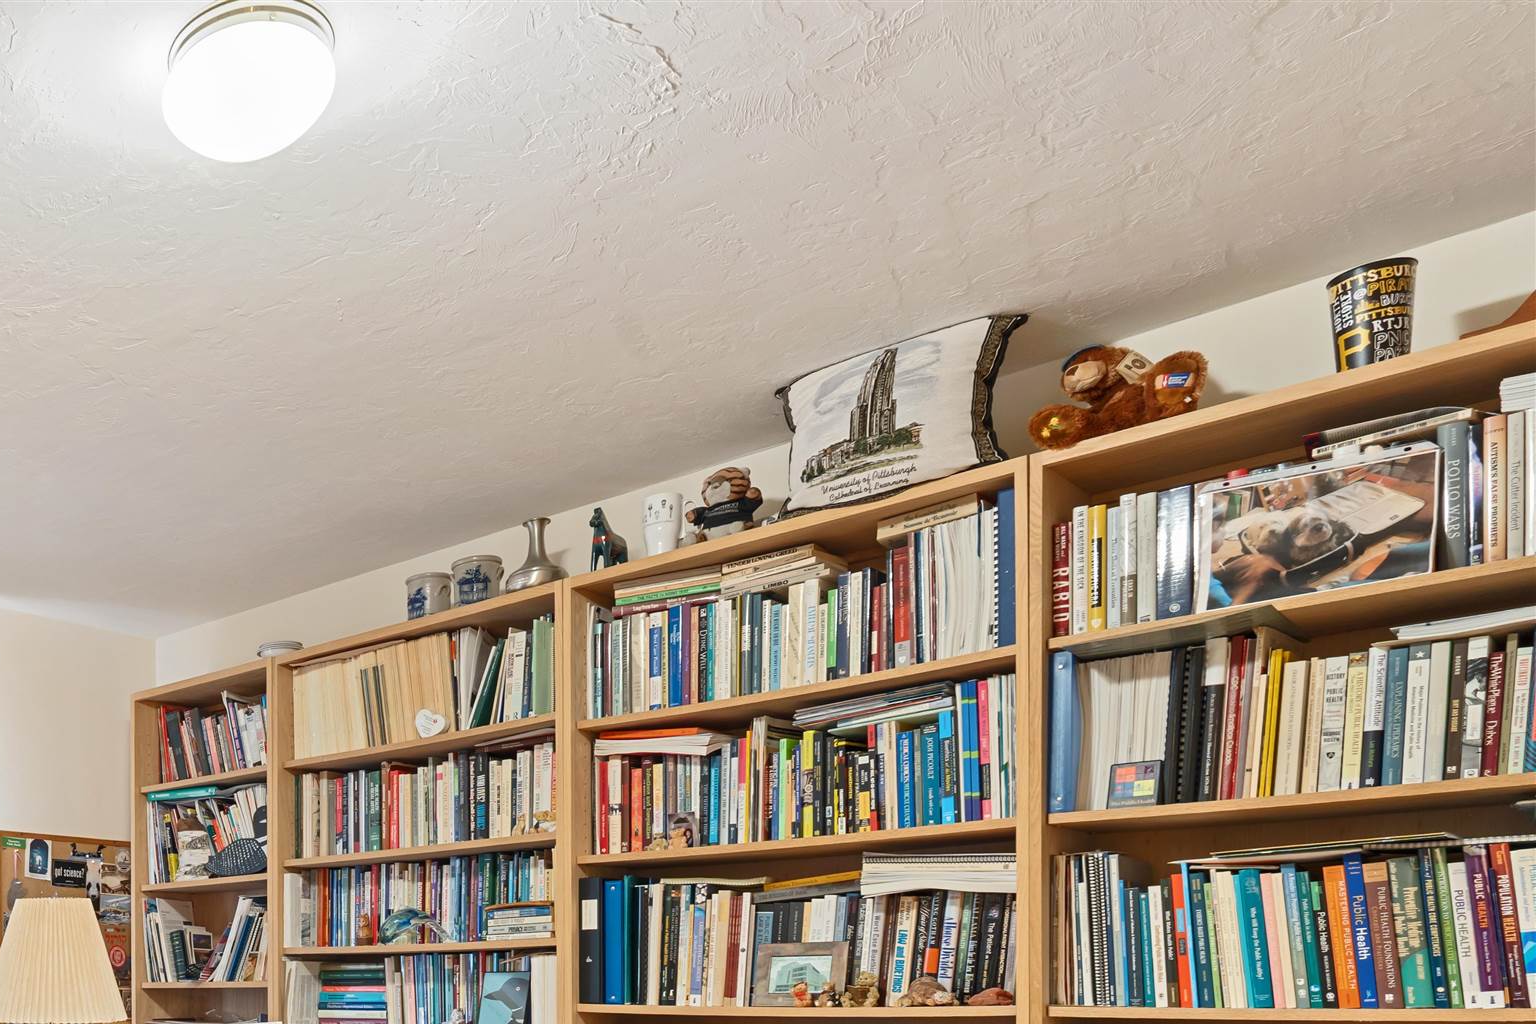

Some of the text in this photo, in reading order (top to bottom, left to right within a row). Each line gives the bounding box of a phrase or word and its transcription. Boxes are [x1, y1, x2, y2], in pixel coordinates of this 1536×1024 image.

[1447, 459, 1461, 540] POLIO WARS
[1490, 441, 1499, 548] AUTISM'S FALSE PROPHETS
[1510, 460, 1521, 532] The Cutter Incident
[726, 547, 797, 569] TENDER LOVING GREED
[762, 580, 789, 591] LIMBO
[1052, 566, 1070, 623] RABID
[699, 629, 709, 671] DYING WELL
[1373, 654, 1387, 727] The Scientific Attitude
[926, 737, 935, 780] JODI PICOULT
[1484, 720, 1498, 746] Dubos
[54, 865, 85, 879] got science?
[1352, 895, 1370, 961] Public Health
[1394, 916, 1407, 935] Public
[1402, 886, 1424, 949] Preventive Medicine
[1454, 889, 1471, 958] PUBLIC HEALTH
[1473, 873, 1489, 929] PUBLIC HEALTH
[1497, 874, 1518, 942] POPULATION HEALTH
[857, 922, 865, 940] Health
[869, 915, 881, 976] Worst Case Bioethic
[941, 921, 958, 947] House
[984, 922, 996, 955] The Patient
[1316, 911, 1330, 953] Public Health
[1337, 880, 1358, 990] MASTERING PUBLIC HEALTH
[1376, 886, 1397, 989] PUBLIC HEALTH FOUNDATIONS
[1397, 937, 1410, 958] Health
[891, 929, 909, 993] LAW and BIOETHICS
[938, 948, 956, 979] Divided
